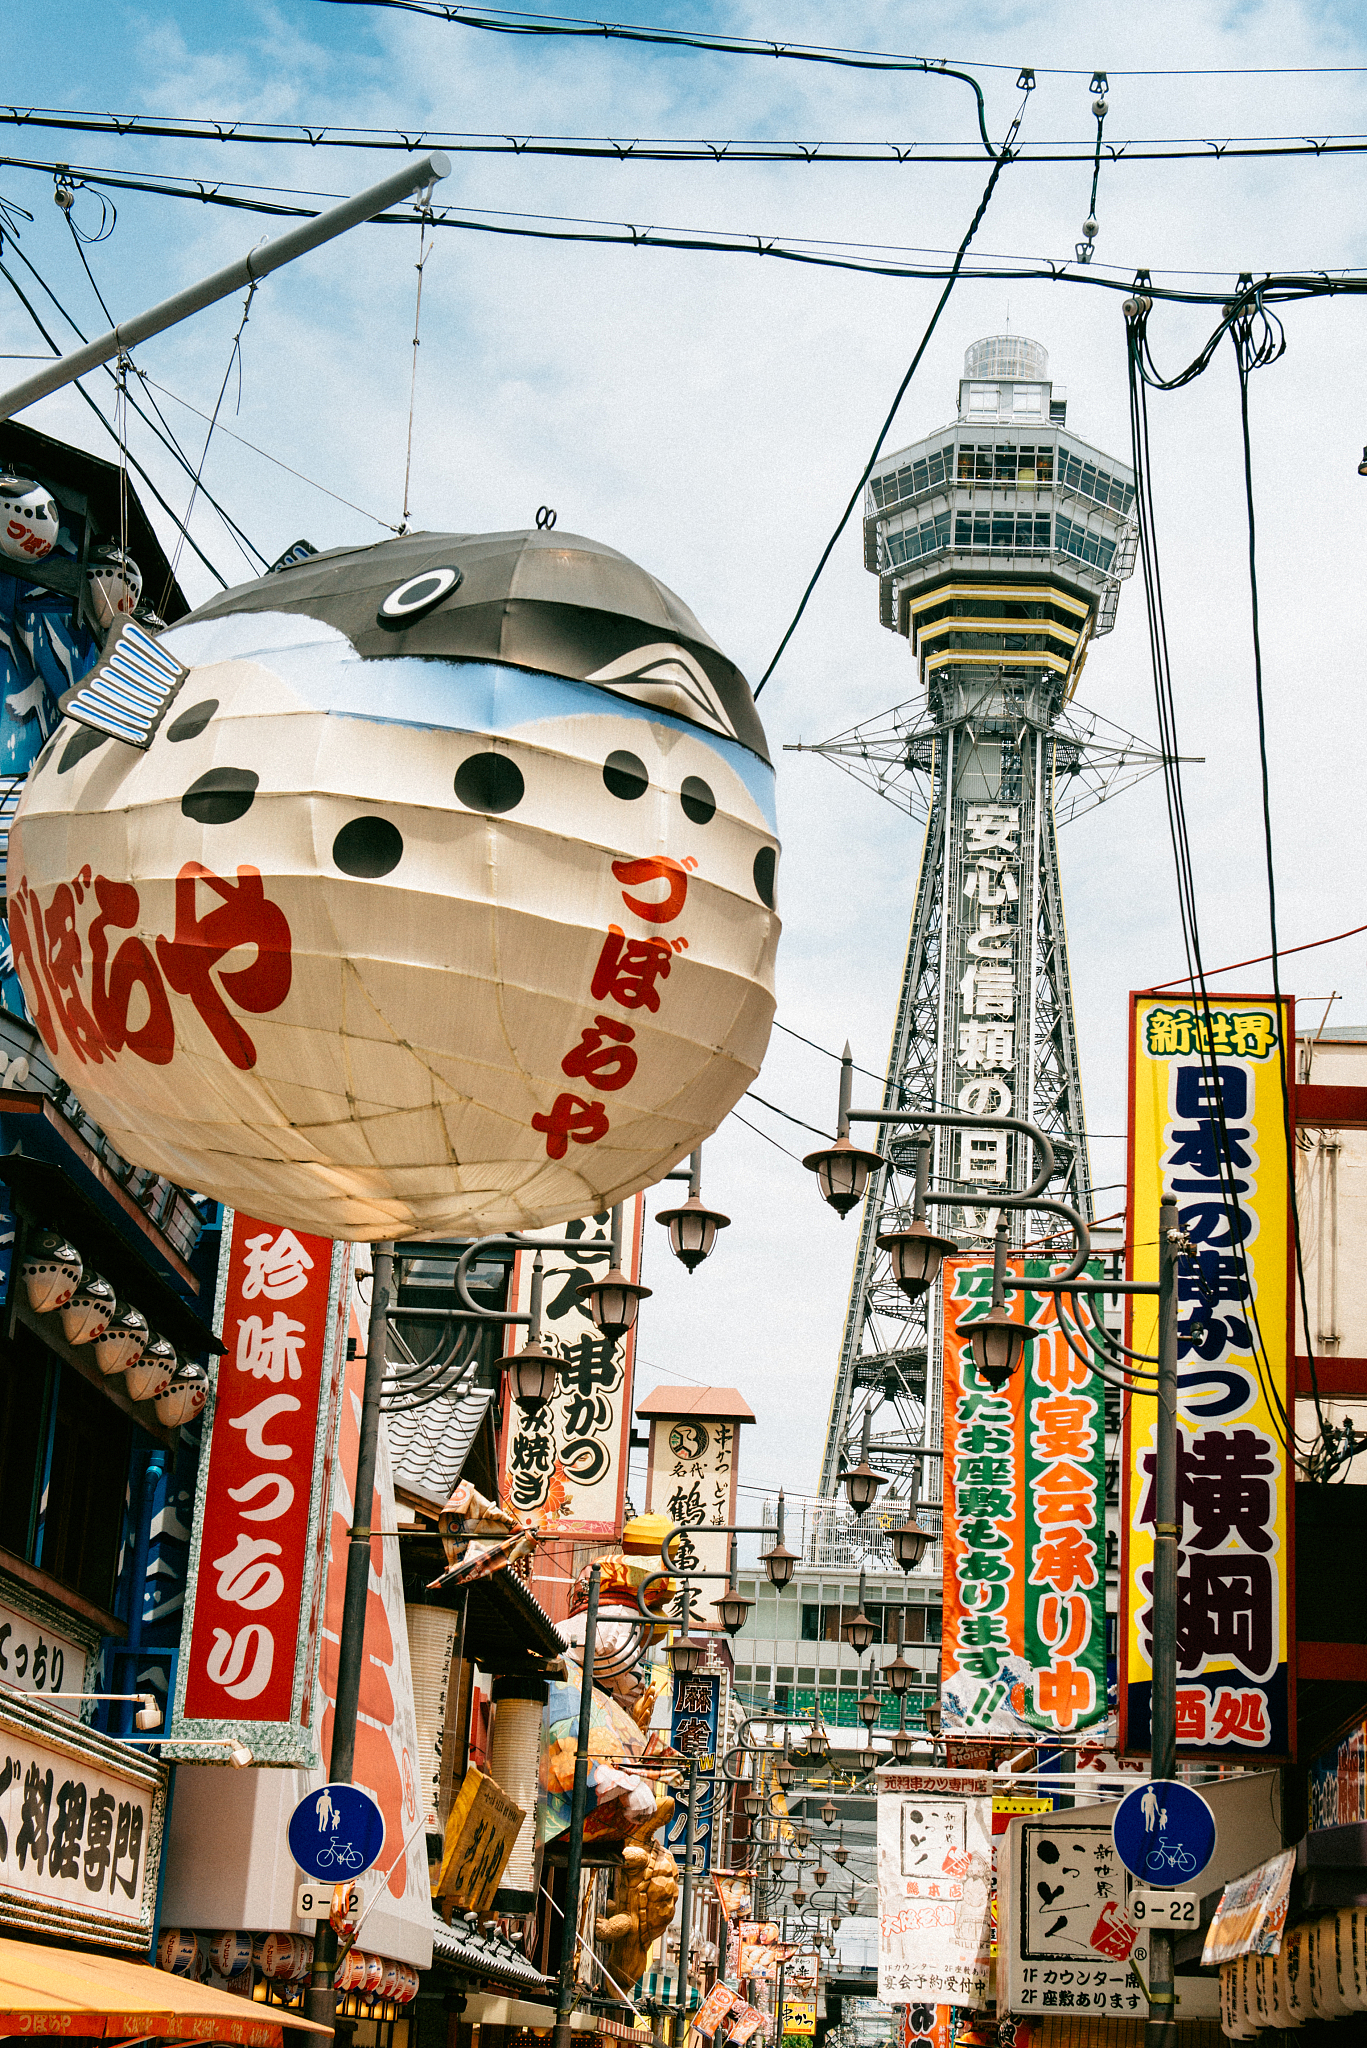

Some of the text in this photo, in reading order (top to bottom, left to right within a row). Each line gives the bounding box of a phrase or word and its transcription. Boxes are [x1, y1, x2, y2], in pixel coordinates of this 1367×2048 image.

[531, 856, 698, 1160] づぼらや
[1147, 1009, 1277, 1056] 新世界
[512, 1332, 556, 1505] み焼き
[561, 1334, 618, 1482] 串かつ
[206, 1227, 315, 1701] 珍味てっちり
[669, 1462, 708, 1480] 名代
[713, 1423, 733, 1475] 串かつ
[954, 1267, 1016, 1727] 広々したお座敷もあります!!
[1139, 1427, 1276, 1677] 横綱
[673, 1677, 713, 1753] 麻雀
[884, 1775, 988, 1793] 元祖串カツ専門店
[1094, 1843, 1119, 1899] 新世界
[301, 1893, 360, 1913] 9-2
[1133, 1900, 1195, 1922] 9-22
[883, 1974, 986, 1997] 宴会予約受付中
[1021, 1988, 1141, 2010] 2F 座敷あります
[1022, 1968, 1038, 1983] 1F
